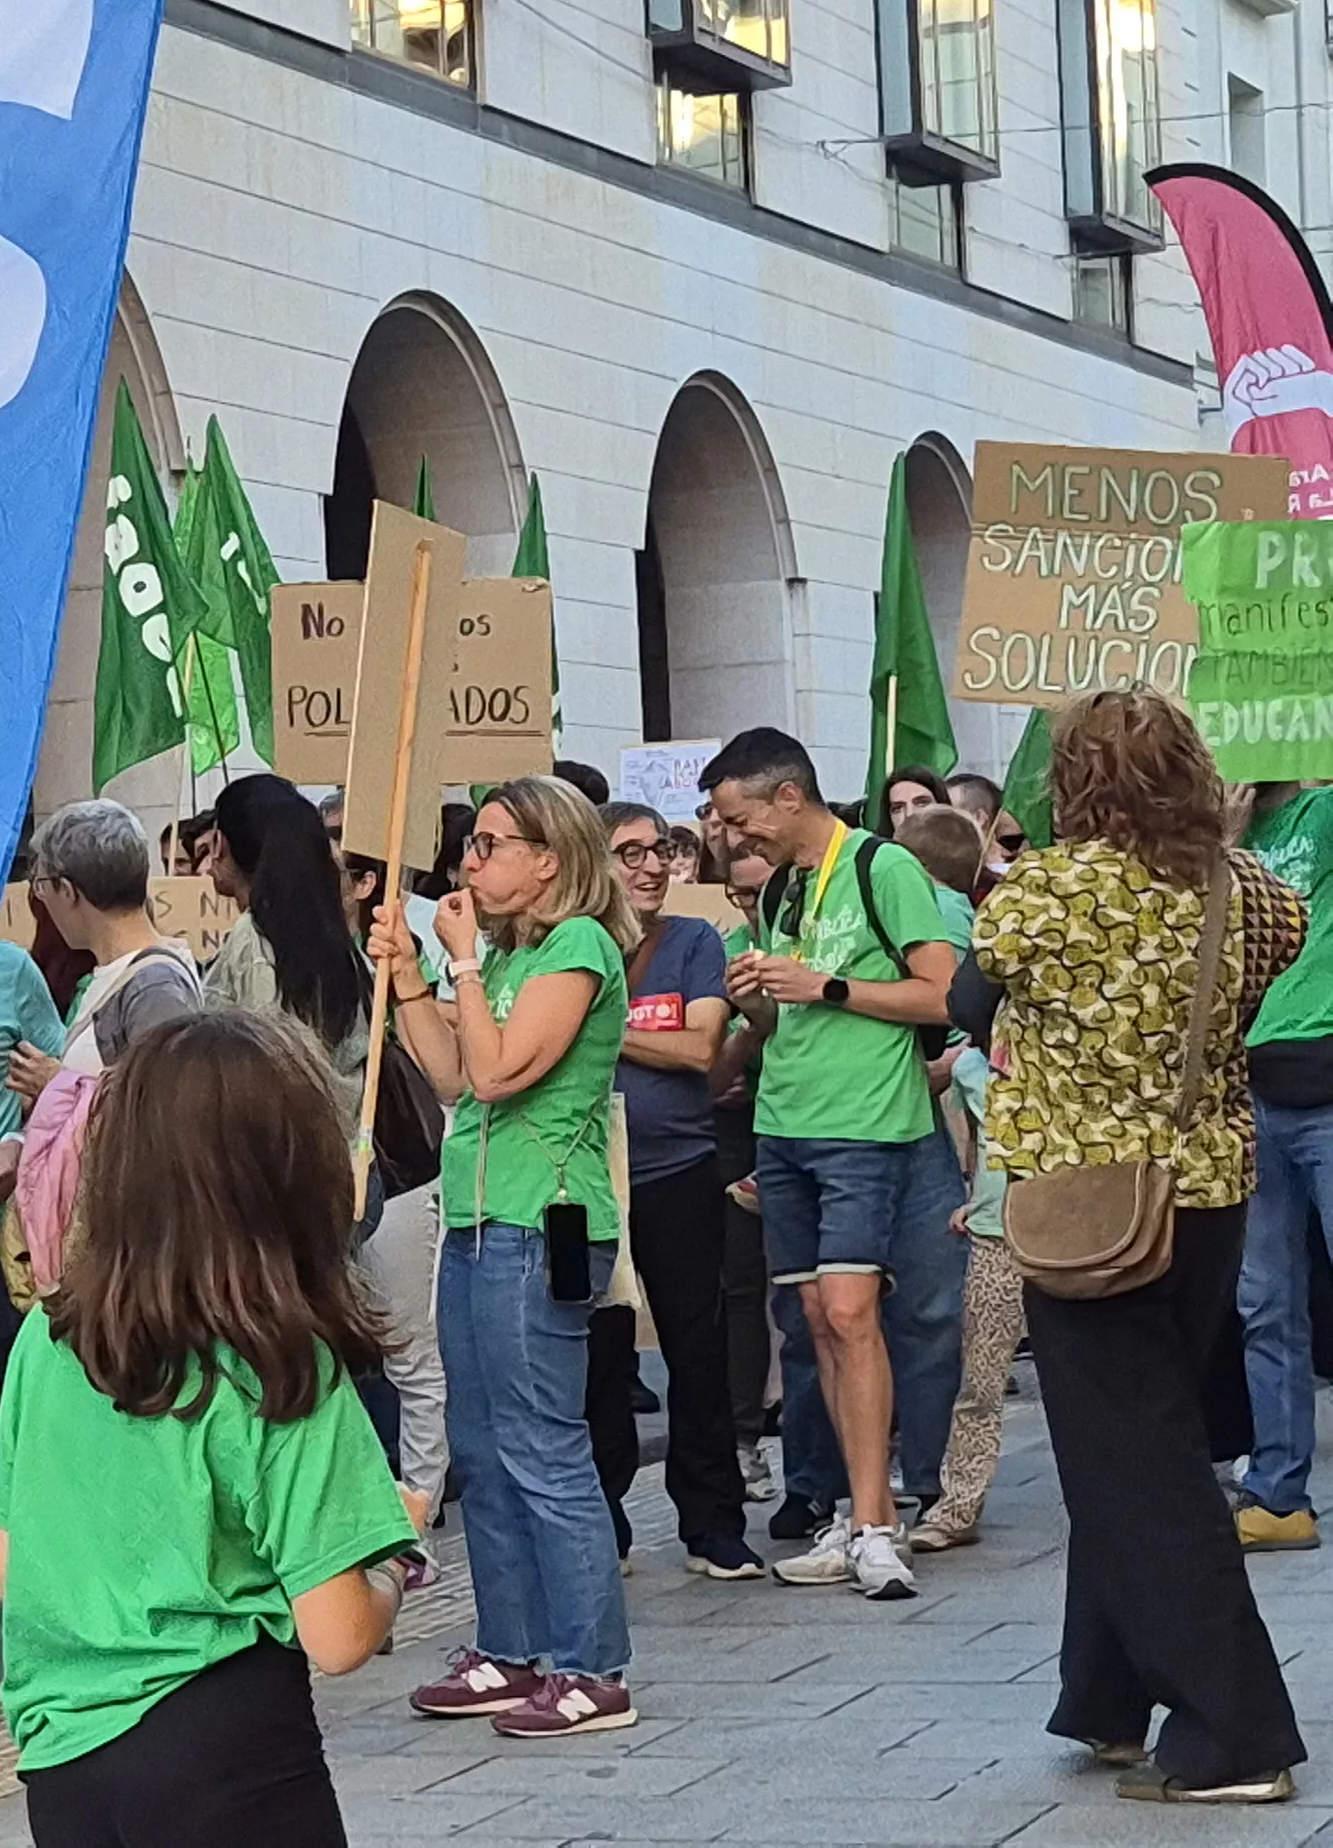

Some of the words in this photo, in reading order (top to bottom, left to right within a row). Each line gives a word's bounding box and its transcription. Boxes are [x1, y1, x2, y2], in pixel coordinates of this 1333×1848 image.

[1010, 460, 1223, 525] MENOS
[1255, 531, 1333, 590] PR
[1058, 581, 1162, 634] MÁS
